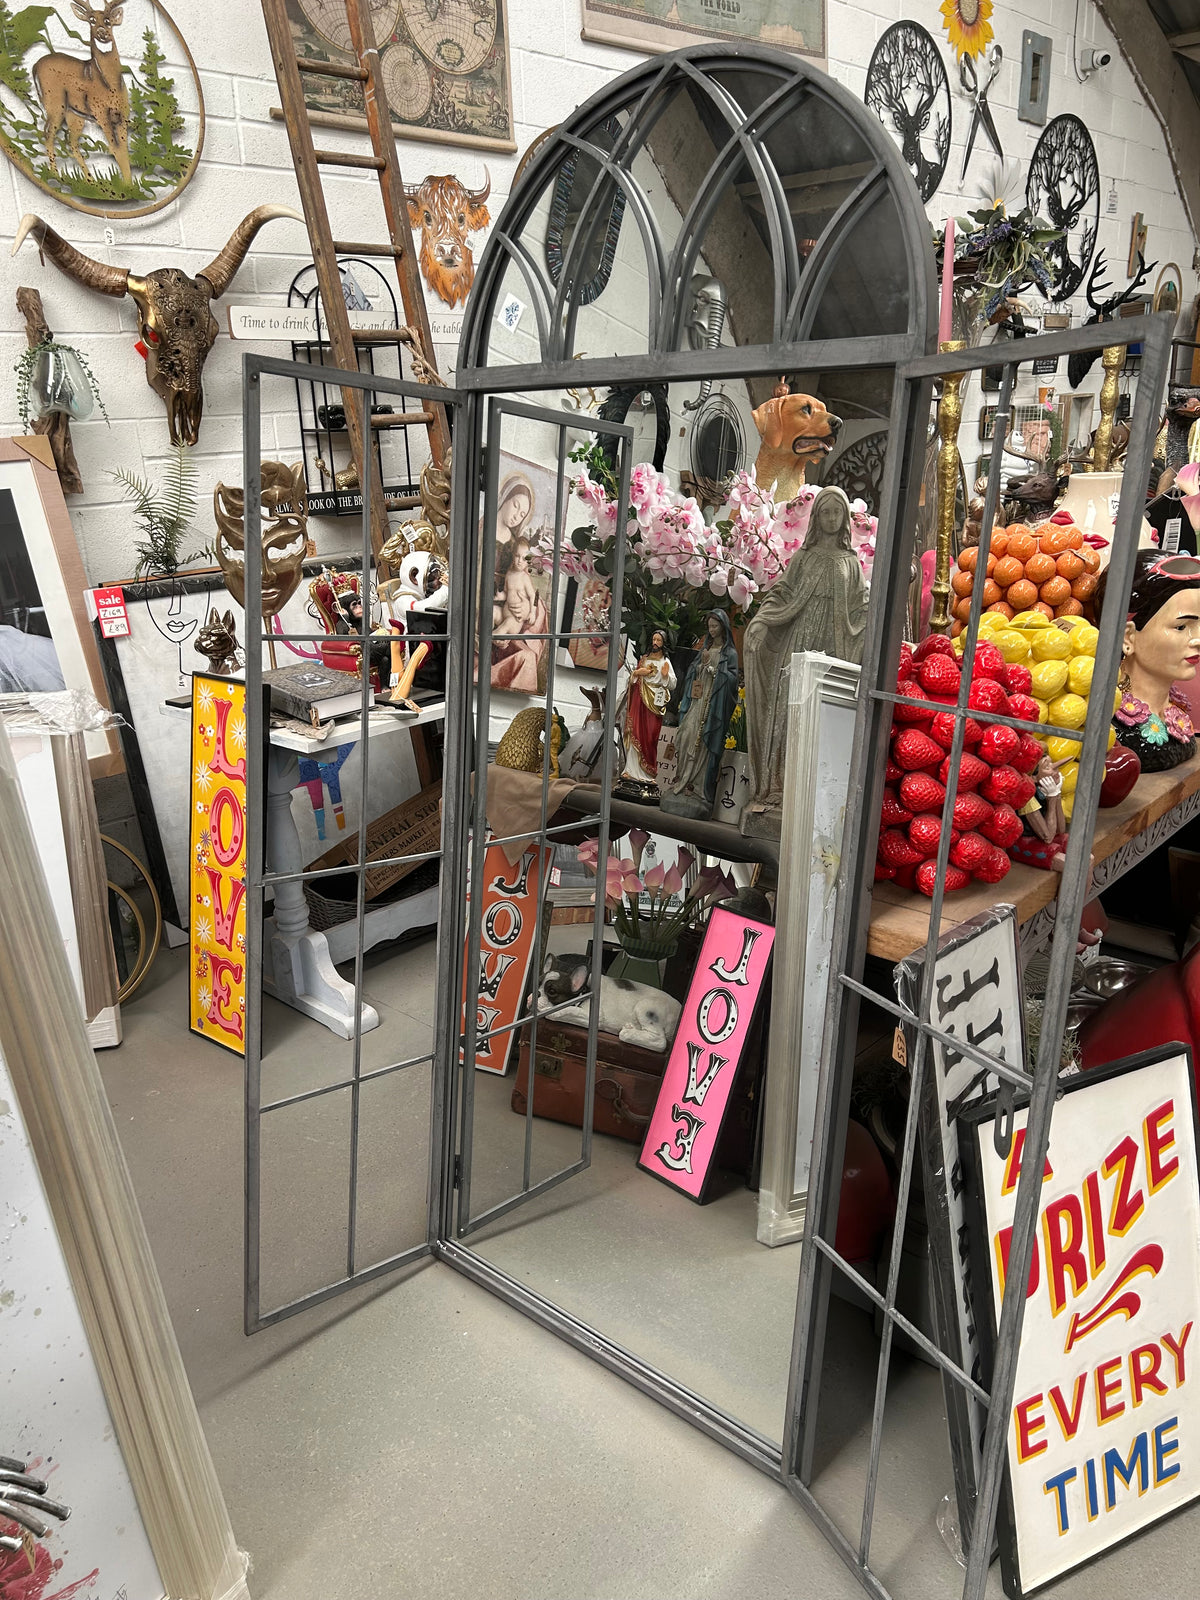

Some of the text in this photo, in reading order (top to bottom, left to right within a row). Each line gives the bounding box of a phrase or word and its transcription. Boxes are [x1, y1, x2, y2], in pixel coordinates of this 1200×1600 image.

[716, 0, 741, 14] WORLD
[239, 315, 266, 329] Time
[269, 318, 280, 329] to
[282, 316, 310, 331] drink
[431, 321, 441, 334] he
[307, 498, 325, 511] OOK
[337, 496, 353, 508] THE
[98, 594, 121, 606] sale
[109, 623, 128, 634] £89
[356, 818, 415, 858] ENERAL
[414, 798, 440, 821] STO
[398, 826, 428, 850] MARKET
[203, 696, 247, 1043] LOVE
[1014, 1321, 1194, 1465] EVERY
[1043, 1416, 1181, 1537] TIME
